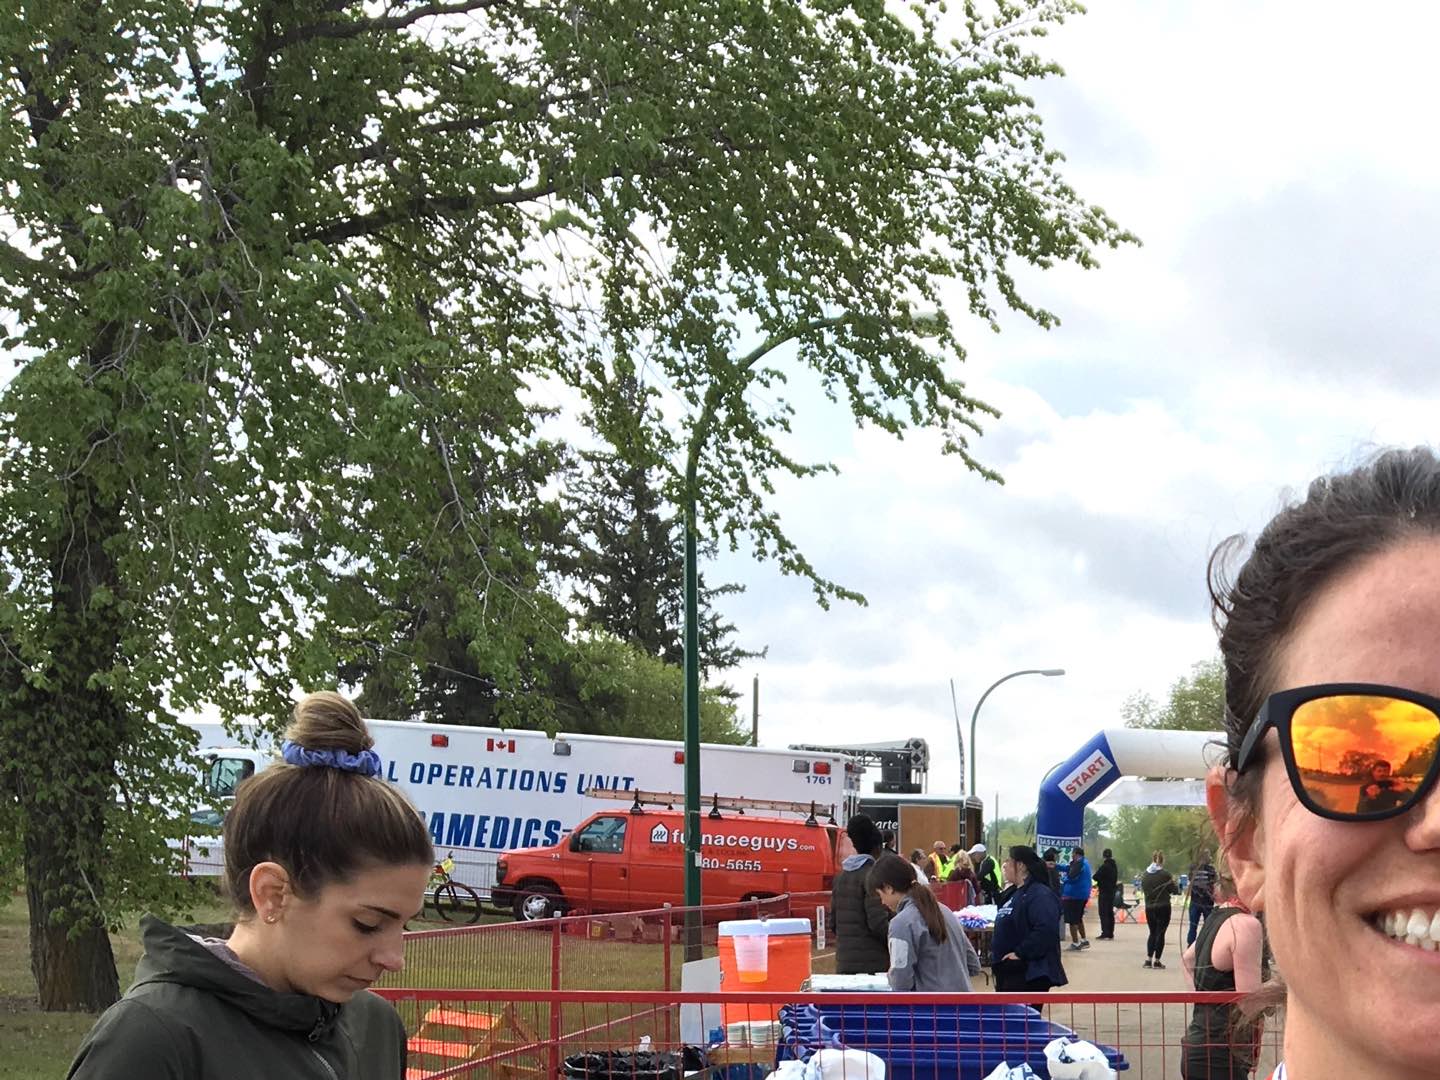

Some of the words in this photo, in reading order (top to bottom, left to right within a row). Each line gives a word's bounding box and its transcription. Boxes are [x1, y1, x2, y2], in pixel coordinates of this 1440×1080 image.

[387, 760, 399, 783] L
[409, 762, 568, 793] OPERATIONS
[576, 773, 635, 795] UNIT
[806, 775, 833, 785] 1761
[1065, 756, 1106, 796] START
[420, 810, 562, 849] AMEDICS
[702, 857, 762, 871] 80-5655
